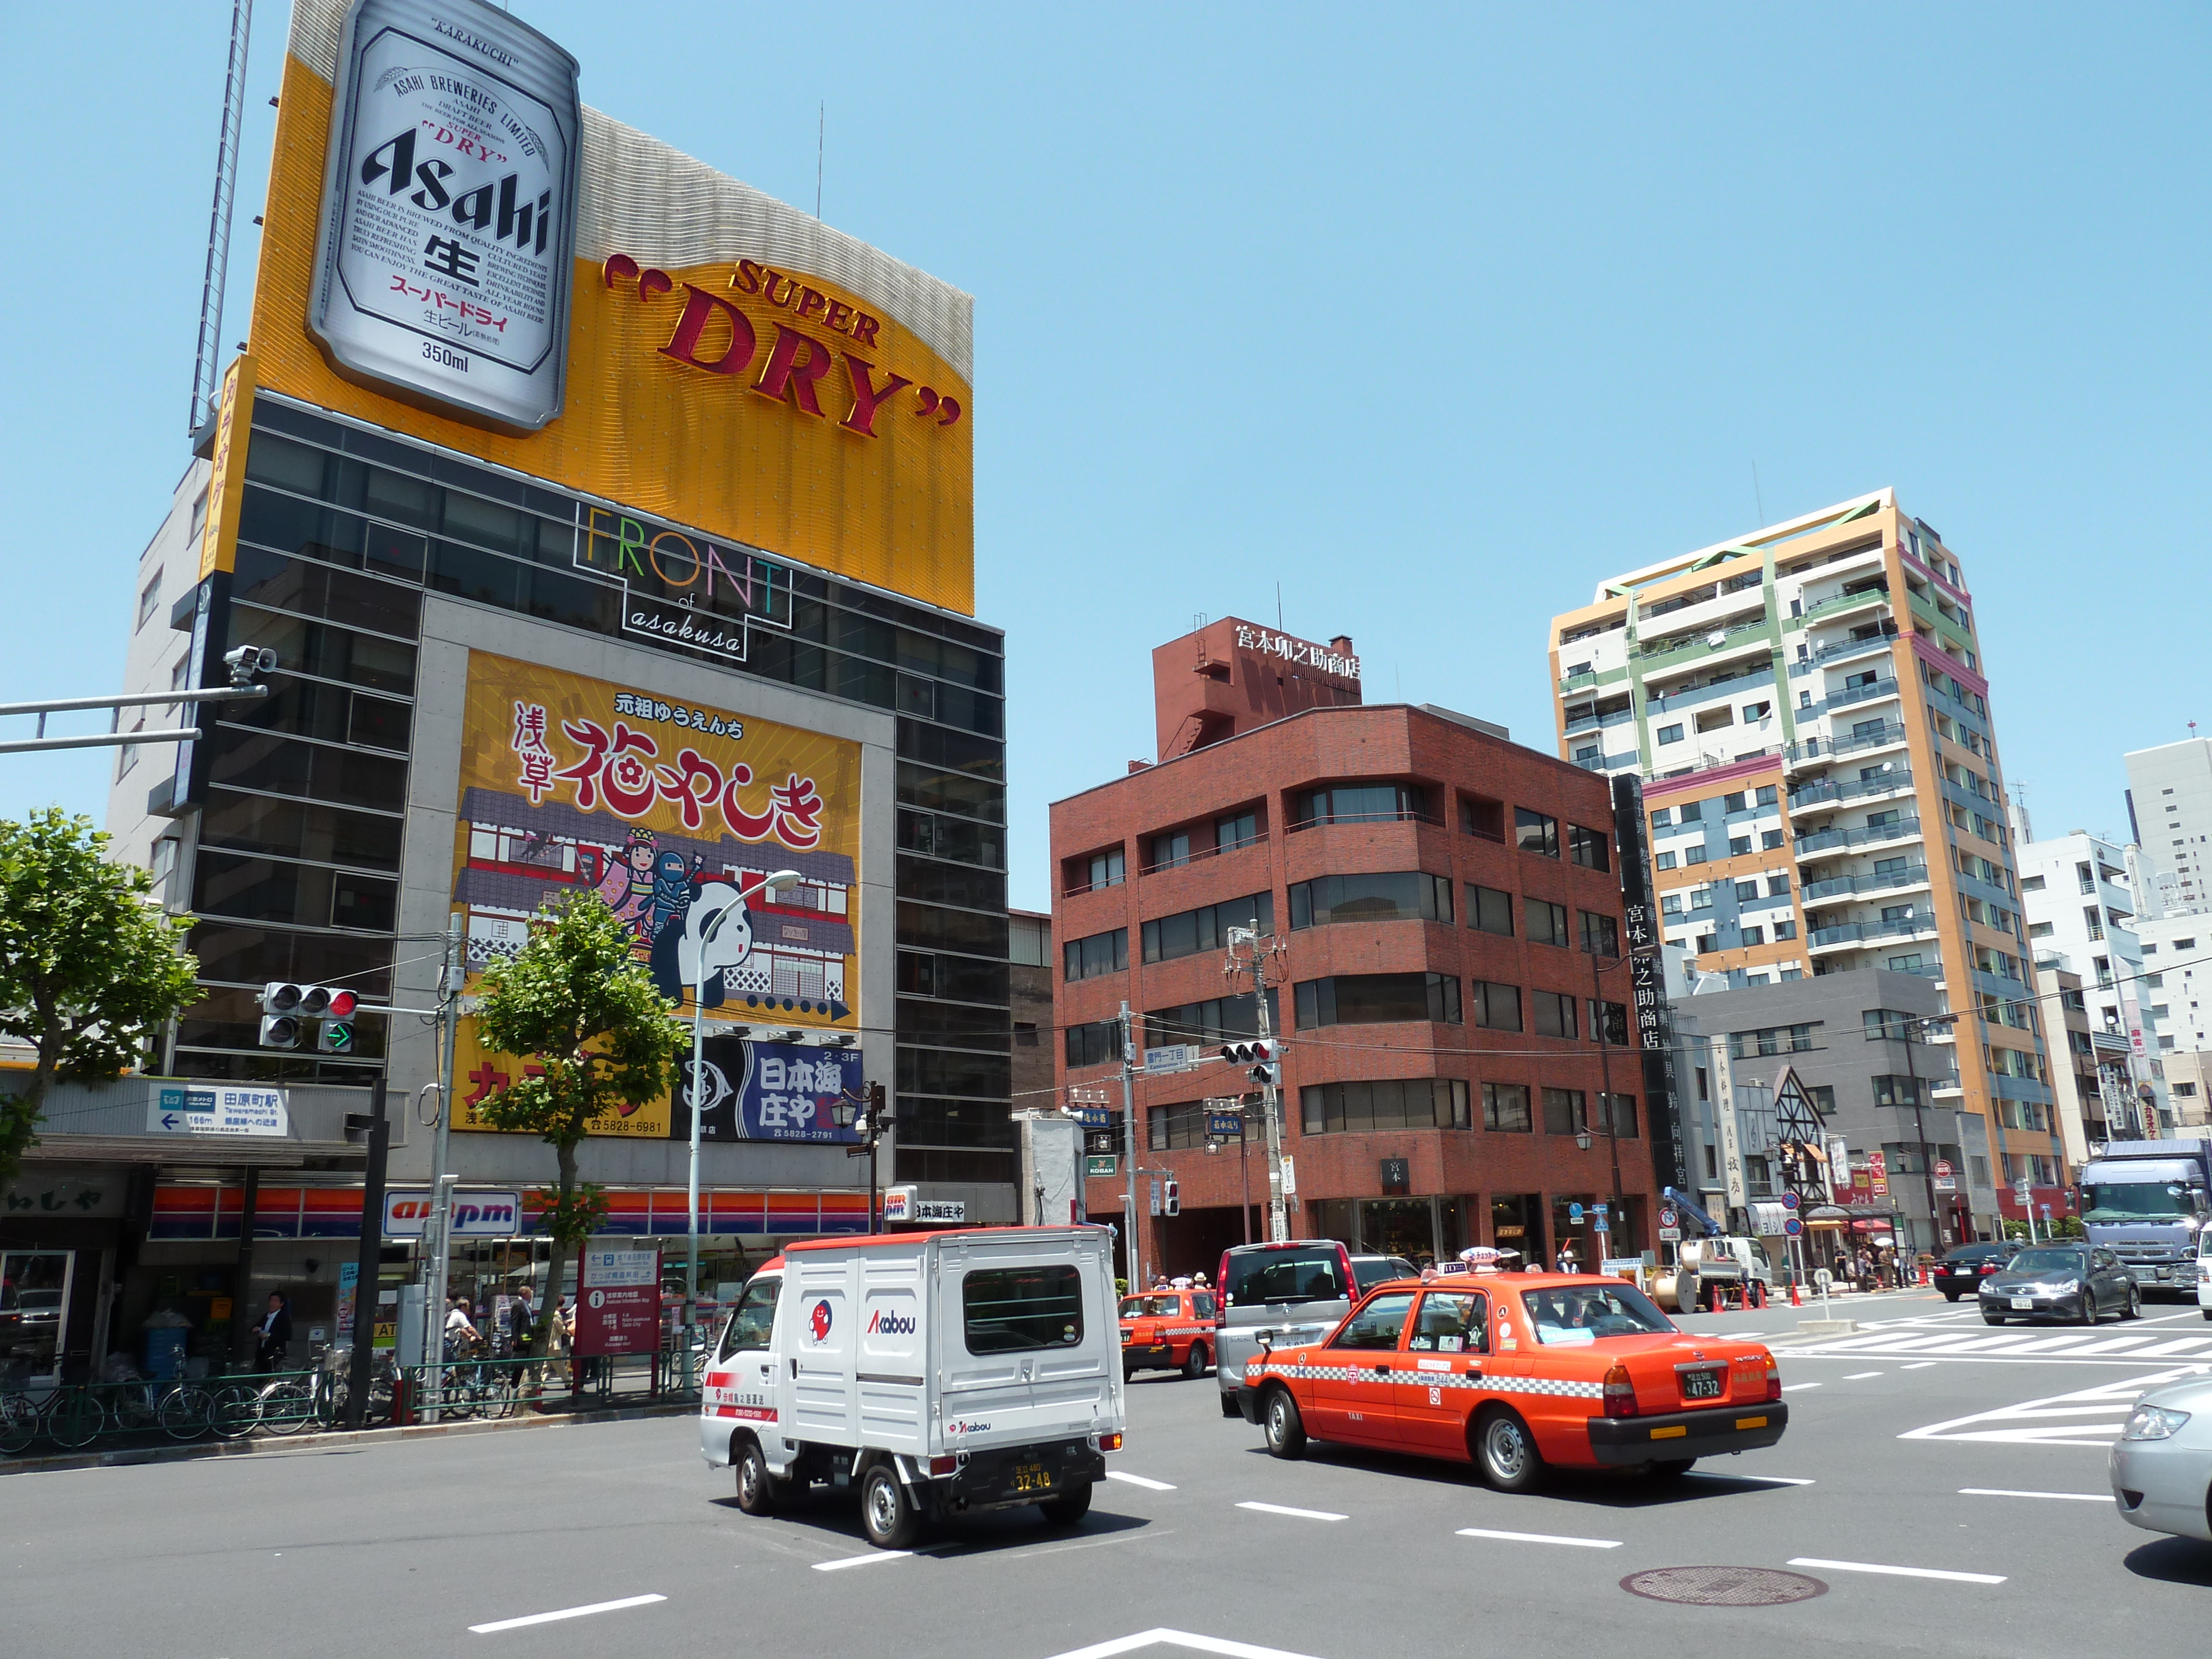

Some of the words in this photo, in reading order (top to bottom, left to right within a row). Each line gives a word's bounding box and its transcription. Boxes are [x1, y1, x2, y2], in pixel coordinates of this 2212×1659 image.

[393, 75, 425, 97] ASAHI
[430, 75, 498, 115] BREWERIES
[500, 112, 536, 156] LIMITED
[421, 102, 433, 111] THE
[435, 108, 452, 120] BEER
[452, 116, 466, 126] FOR
[466, 122, 479, 133] ALL
[439, 101, 467, 117] DRAFT
[468, 114, 493, 131] BEER
[453, 98, 481, 115] ASAHI
[446, 121, 482, 142] SUPER
[361, 127, 552, 258] Asahi
[352, 234, 369, 246] SATIN
[356, 197, 363, 206] BY
[364, 201, 383, 214] USING
[383, 211, 399, 220] OUR
[399, 215, 420, 228] PURE
[487, 252, 529, 273] CULTURED
[529, 268, 547, 281] YEAST
[357, 189, 377, 201] ASAHI
[377, 196, 397, 210] BEER
[398, 205, 405, 213] IS
[406, 208, 443, 228] BREWED
[444, 225, 469, 240] FROM
[471, 236, 505, 254] QUALITY
[505, 251, 548, 273] INGREDIENTS
[367, 212, 382, 222] OUR
[380, 218, 419, 238] ADVANCED
[487, 261, 517, 277] BREWING
[353, 225, 371, 237] TRULY
[371, 232, 417, 256] REFRESHING
[486, 278, 534, 304] DRINKABILITY
[354, 216, 375, 230] ASAHI
[375, 225, 399, 239] BEER
[399, 234, 418, 247] HAS
[486, 270, 522, 289] EXCELLENT
[423, 234, 481, 288] 生
[351, 243, 364, 254] YOU
[364, 249, 379, 260] CAN
[380, 255, 409, 271] ENJOY
[409, 265, 429, 279] THE
[429, 274, 462, 291] GREAT
[462, 286, 489, 304] TASTE
[490, 299, 503, 308] OF
[502, 304, 526, 318] ASAHI
[390, 274, 508, 333] スーパードライ
[485, 288, 502, 299] ALL
[502, 294, 523, 307] YEAR
[523, 302, 545, 316] ROUND
[728, 258, 881, 349] SUPER
[422, 341, 468, 373] 350ml
[587, 507, 783, 614] FRONT
[678, 592, 695, 609] of
[631, 612, 740, 652] asakusa
[1235, 624, 1360, 681] 宮本卯之助商店
[614, 692, 745, 740] 元祖ゆうえんち
[511, 700, 556, 806] 浅草
[554, 718, 824, 849] 花やしき
[760, 1056, 842, 1095] 日本海
[1147, 1048, 1183, 1064] 雷門一丁目
[225, 1093, 278, 1108] 田原町駅
[759, 1092, 816, 1128] 庄や
[603, 1120, 661, 1133] 5828-6981
[783, 1129, 833, 1139] 5828-2791
[1436, 1374, 1448, 1384] 544
[1348, 1412, 1363, 1421] TAXI
[1029, 1463, 1041, 1473] 480
